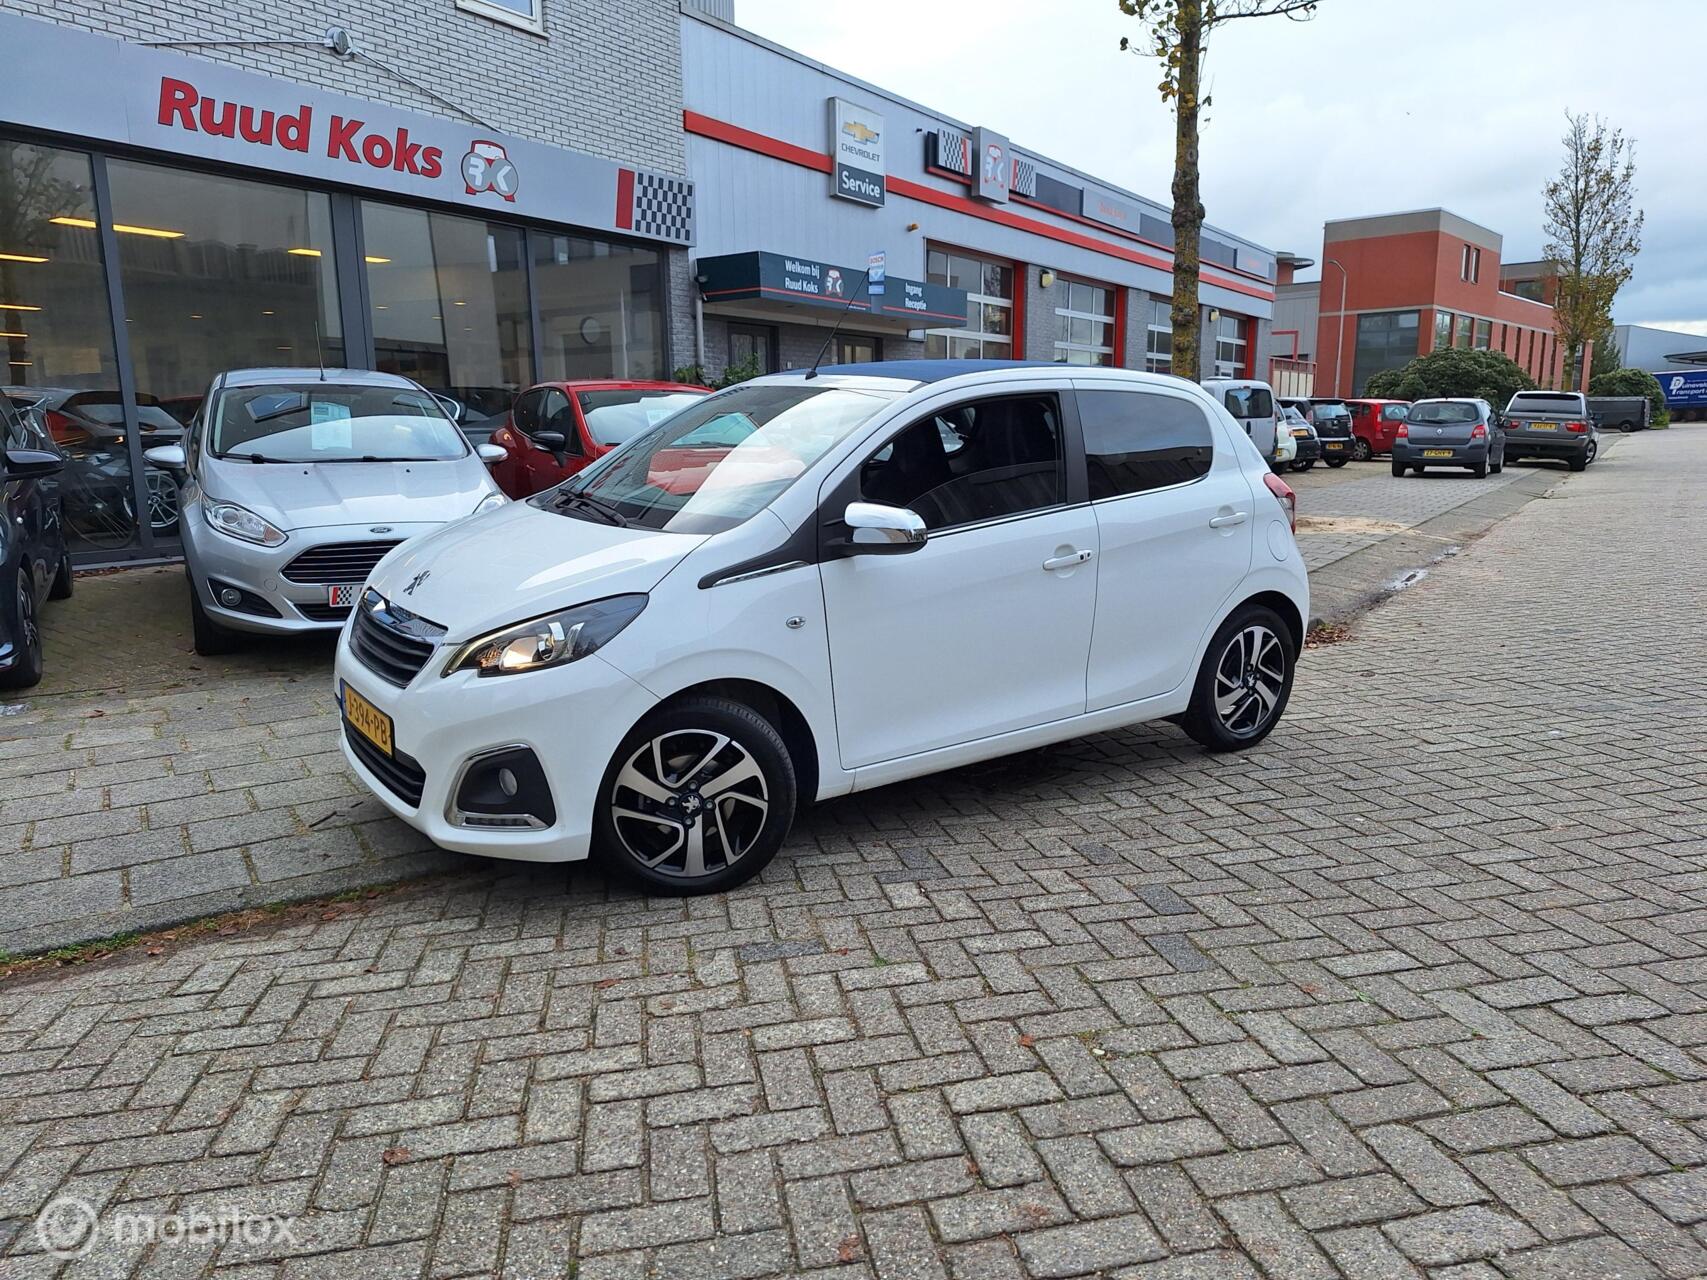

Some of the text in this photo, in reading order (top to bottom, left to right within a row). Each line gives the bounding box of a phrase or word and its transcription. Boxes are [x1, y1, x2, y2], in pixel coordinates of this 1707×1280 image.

[158, 76, 443, 179] Ruud Koks
[841, 143, 881, 162] CHEVROLET
[842, 170, 881, 198] Service
[784, 259, 820, 280] Welkom bij
[785, 276, 819, 294] Ruud Koks
